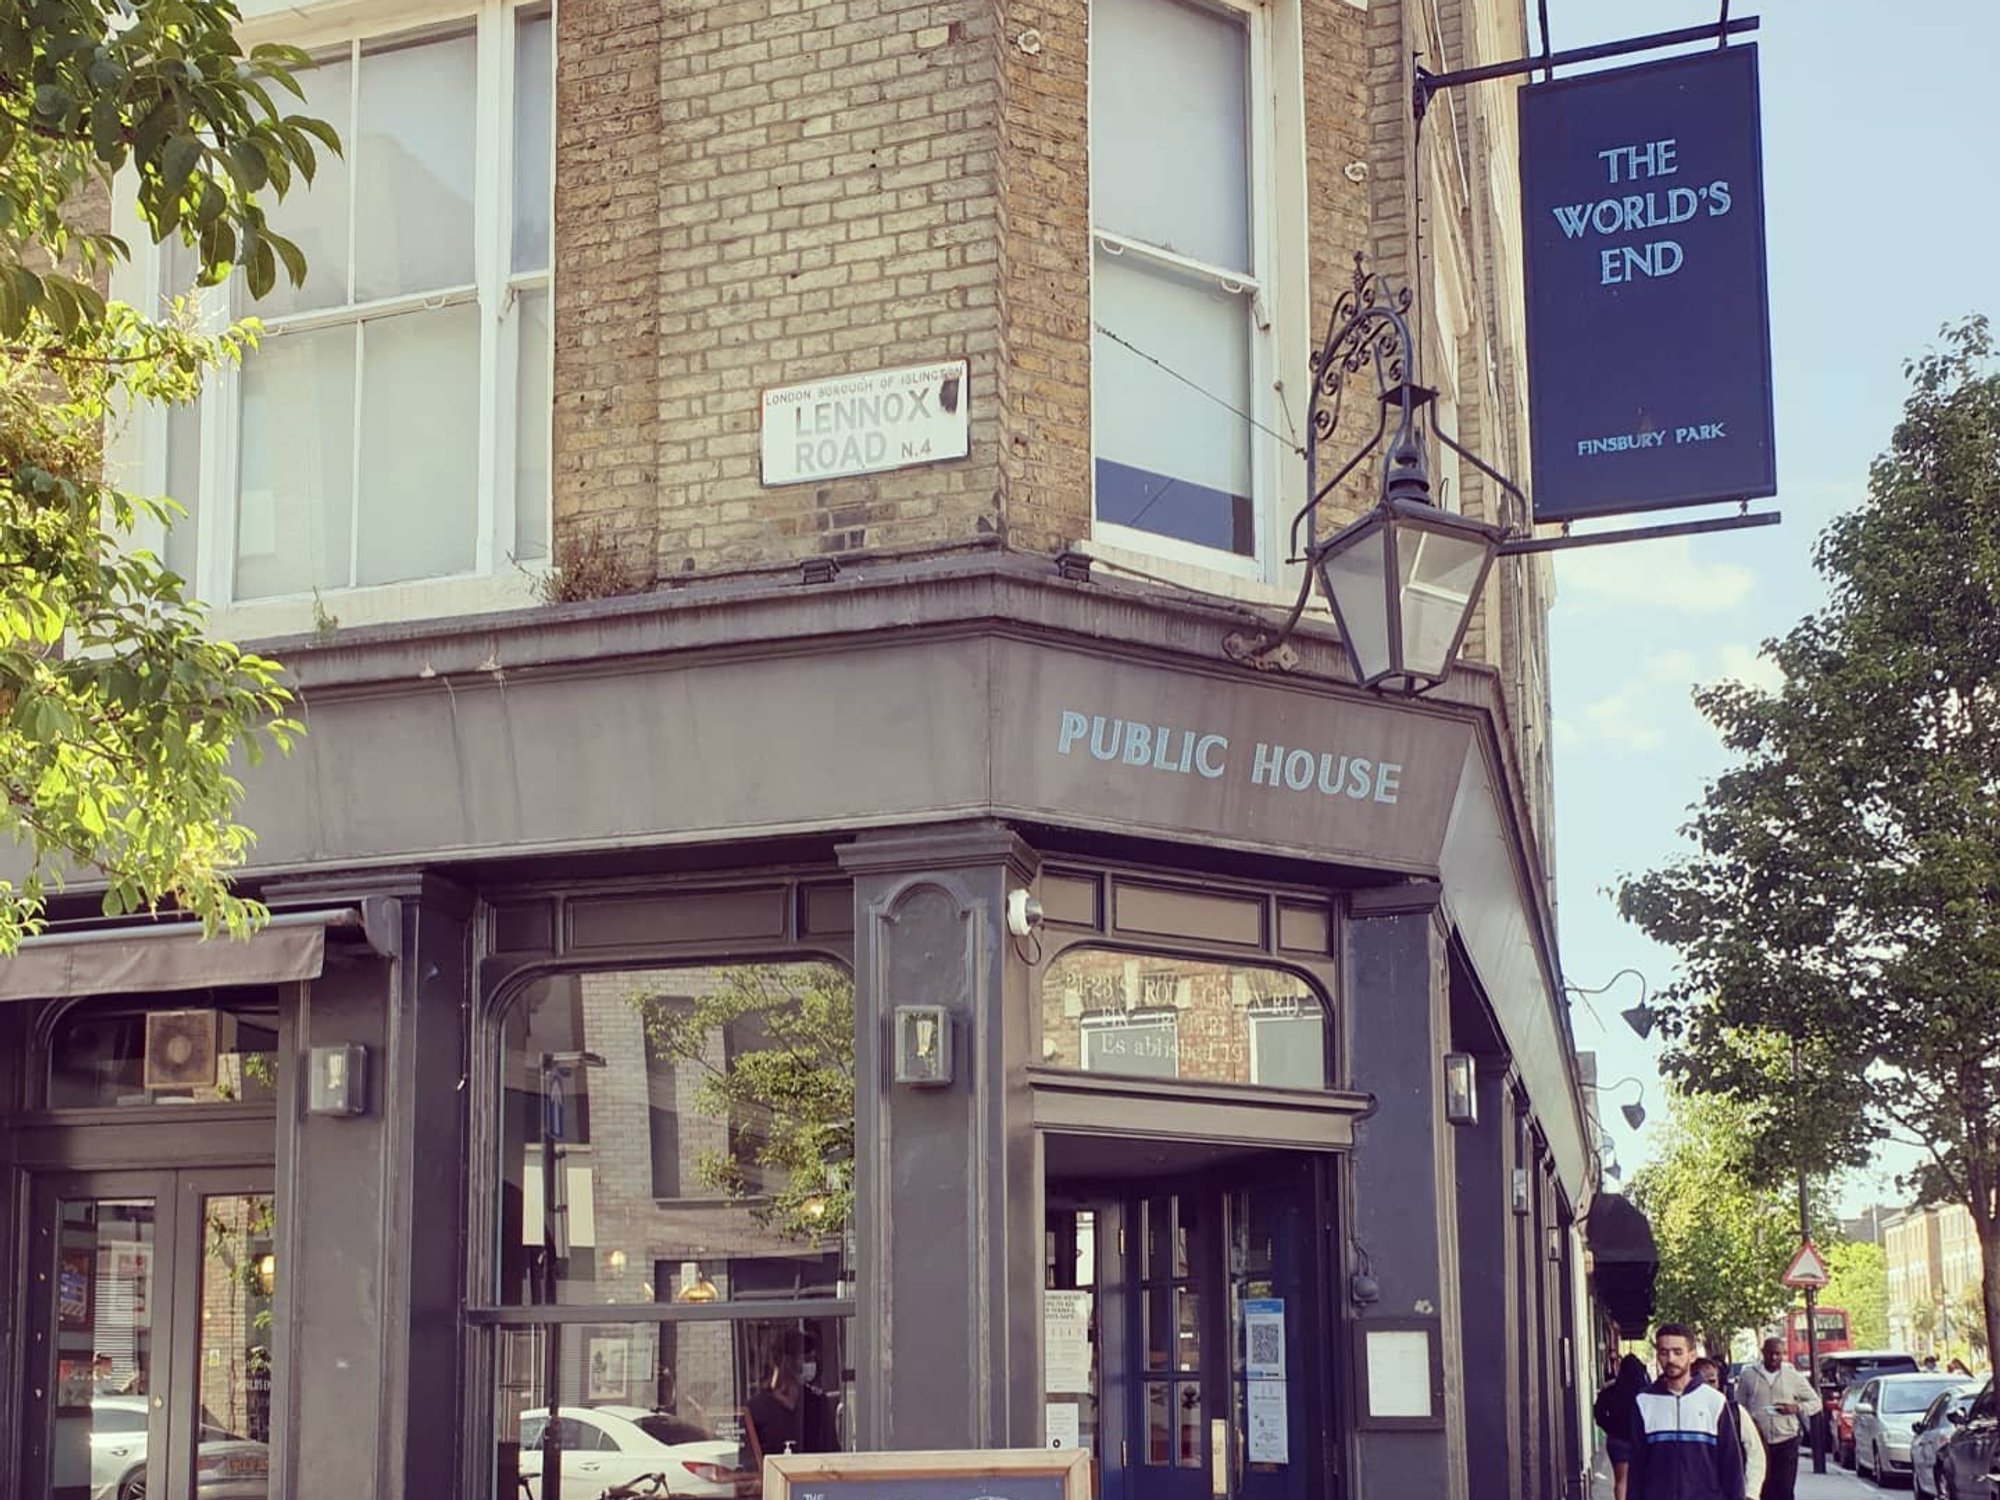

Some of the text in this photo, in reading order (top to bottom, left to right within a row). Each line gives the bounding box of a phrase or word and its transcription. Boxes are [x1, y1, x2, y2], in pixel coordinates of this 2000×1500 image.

[1599, 138, 1678, 183] THE
[1553, 181, 1732, 239] WORLD'S
[1601, 240, 1683, 284] END
[765, 390, 811, 406] LONDON
[818, 381, 873, 398] BOROUGH
[880, 377, 892, 389] OF
[795, 387, 932, 437] LENNOX
[796, 432, 932, 474] ROAD N.4
[1577, 422, 1727, 456] FINSBURY PARK
[1057, 710, 1403, 805] PUBLIC HOUSE
